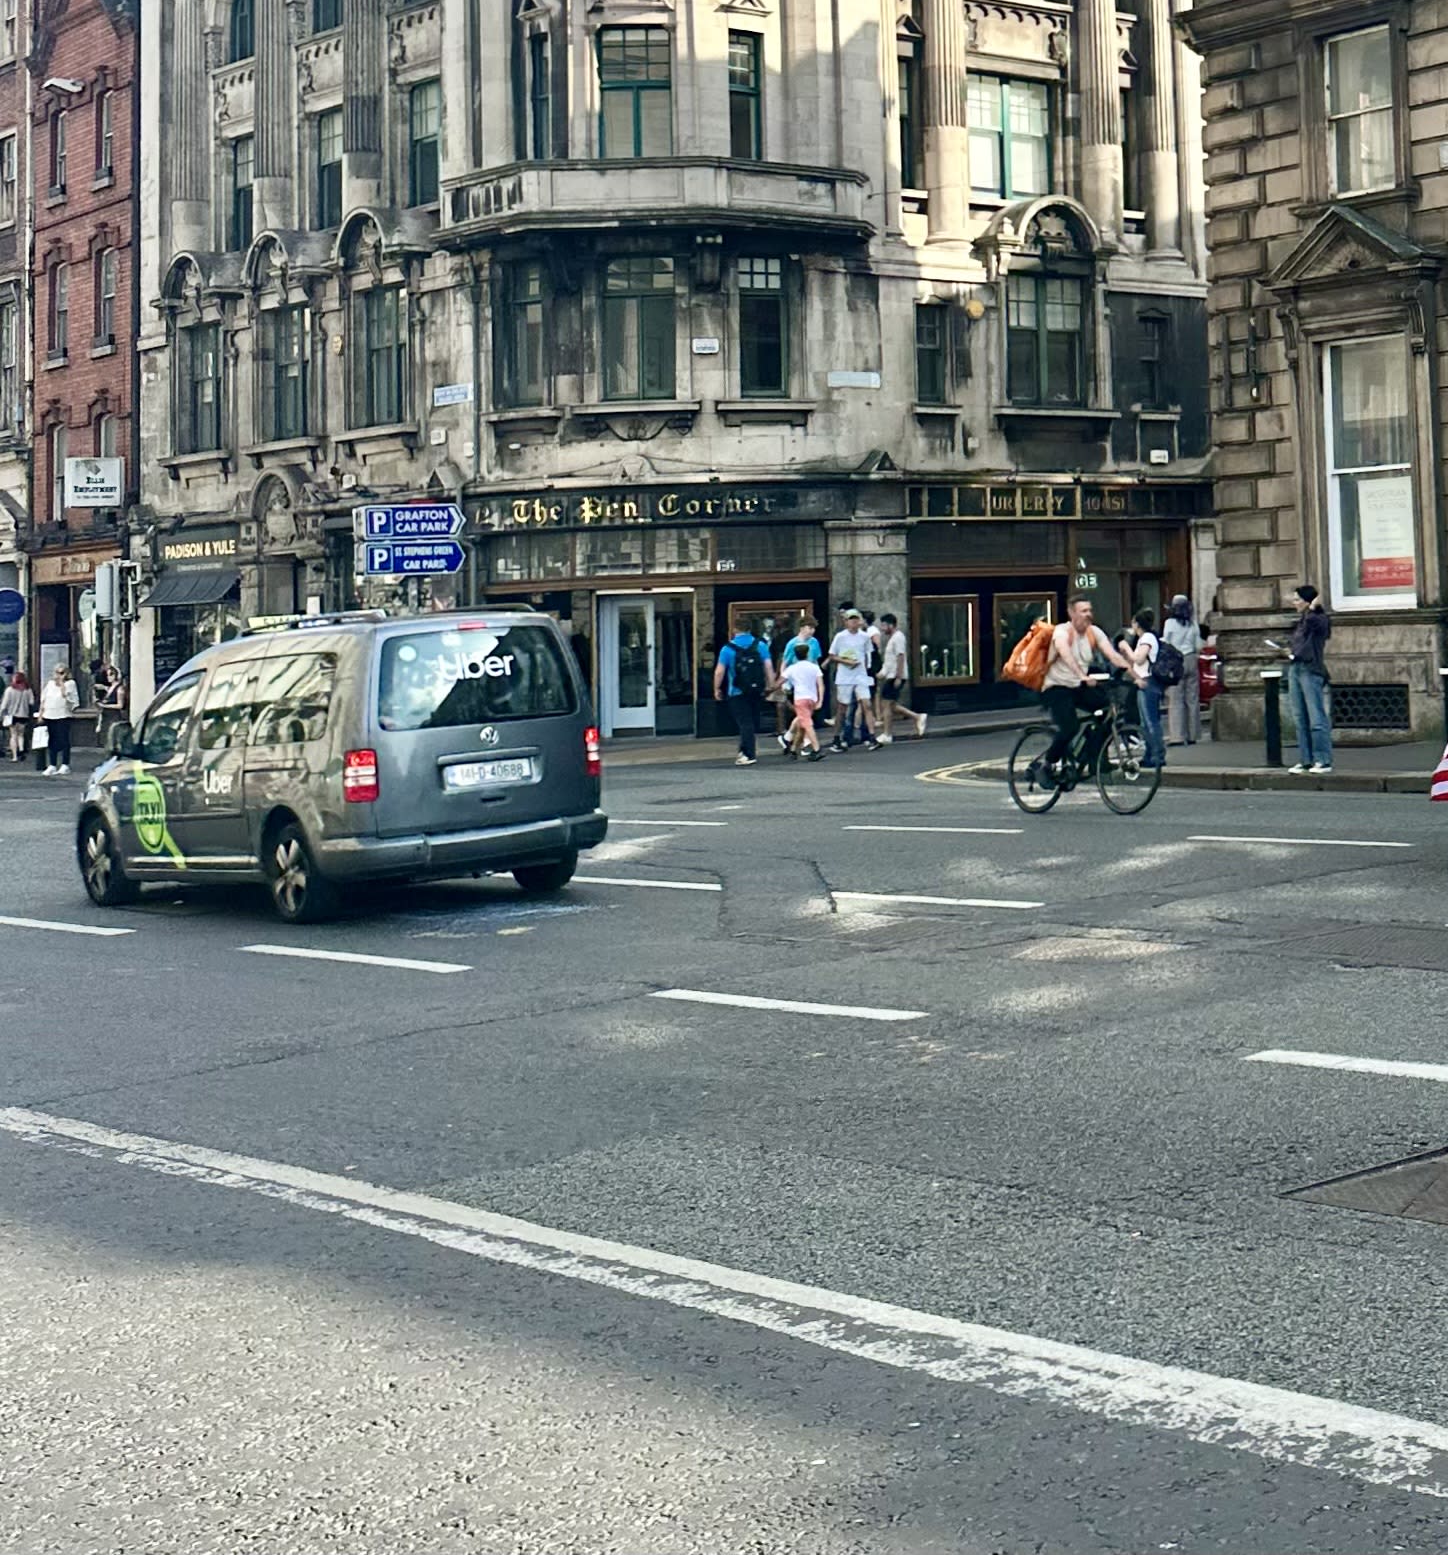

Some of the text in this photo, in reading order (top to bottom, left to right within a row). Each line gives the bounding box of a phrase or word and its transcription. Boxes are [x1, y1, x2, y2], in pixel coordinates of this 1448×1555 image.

[395, 510, 448, 521] GRAFTON
[512, 498, 562, 525] The
[580, 496, 640, 524] Pen
[658, 493, 775, 517] Corner
[395, 521, 449, 533] CAR PARK
[165, 539, 236, 560] PADISON & YULE
[403, 560, 420, 570] CAR
[438, 652, 514, 681] Uber
[203, 769, 234, 794] Uber
